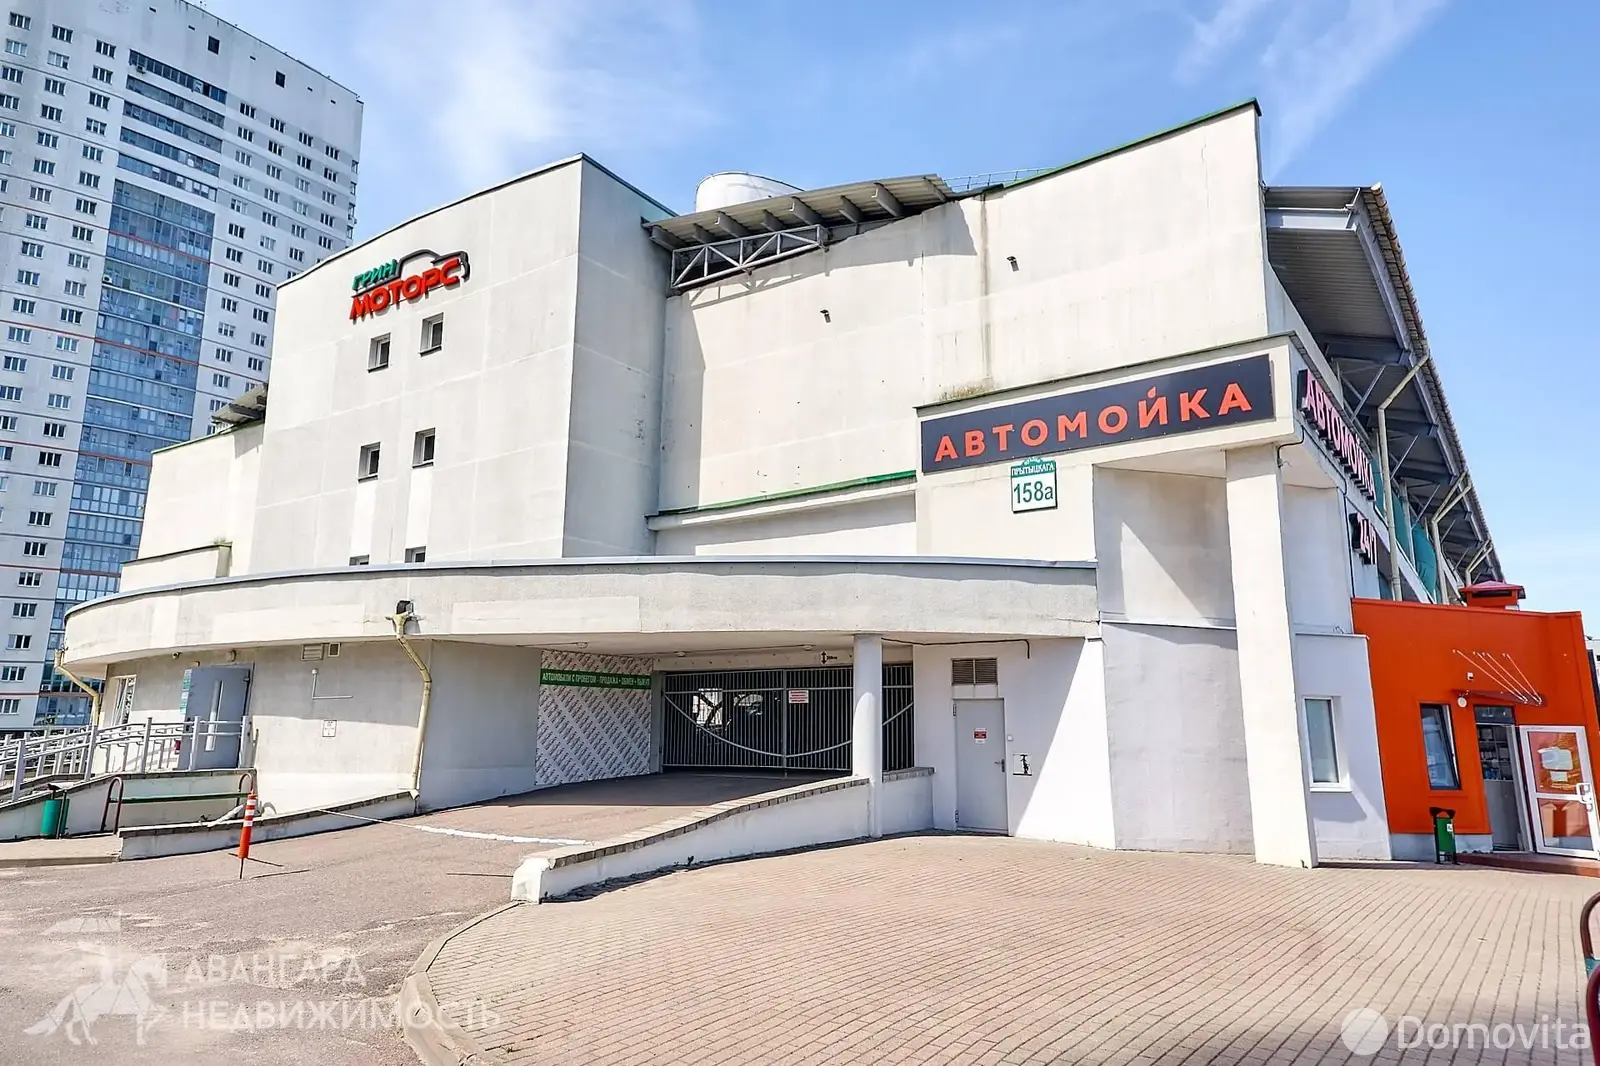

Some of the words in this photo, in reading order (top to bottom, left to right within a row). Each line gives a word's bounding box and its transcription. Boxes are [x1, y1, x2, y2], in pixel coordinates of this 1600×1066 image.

[350, 257, 460, 319] МОТОРС
[352, 259, 398, 291] ГРИН
[934, 382, 1252, 462] АВТОМОЙКА
[1304, 369, 1376, 501] АВТОМОЙКА
[1014, 481, 1053, 504] 158а
